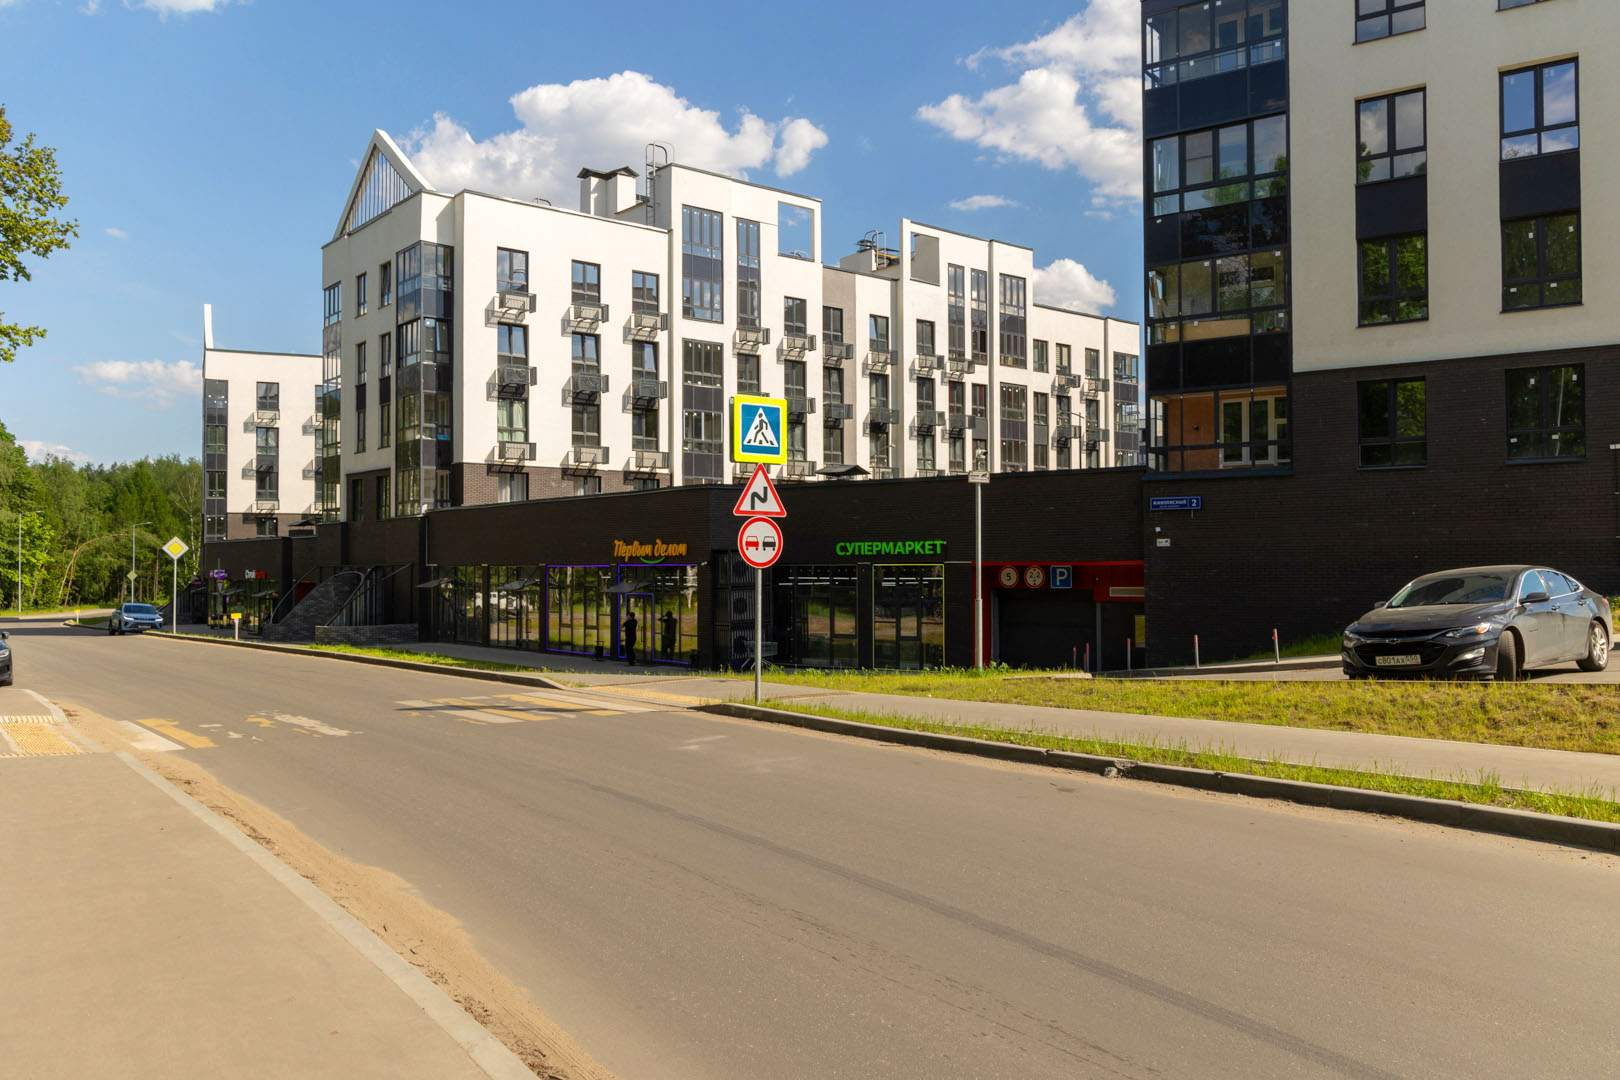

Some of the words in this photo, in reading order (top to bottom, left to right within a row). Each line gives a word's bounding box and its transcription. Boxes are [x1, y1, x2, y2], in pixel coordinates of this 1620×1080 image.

[1191, 499, 1197, 507] 2
[612, 540, 653, 562] Первым
[654, 538, 688, 557] делом
[835, 541, 945, 556] СУПЕРМАРКЕТ
[1006, 572, 1012, 581] 5
